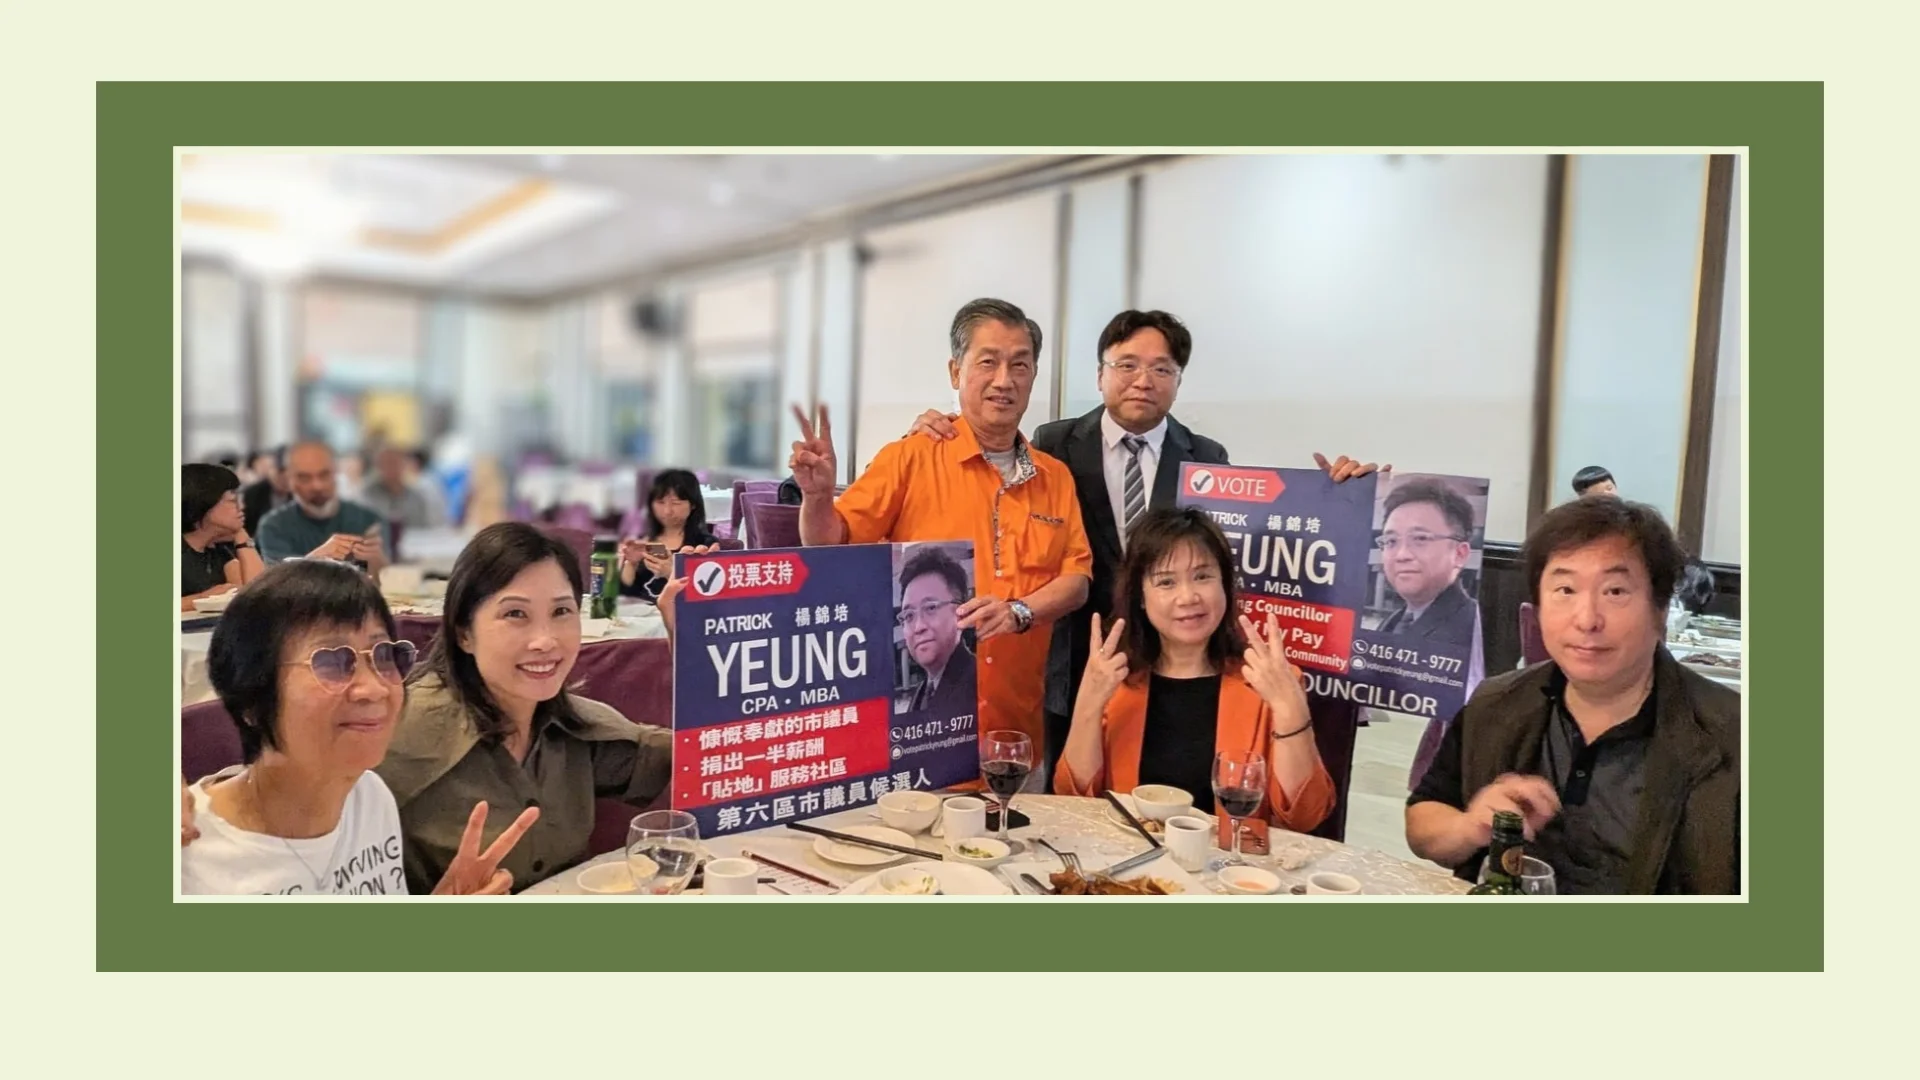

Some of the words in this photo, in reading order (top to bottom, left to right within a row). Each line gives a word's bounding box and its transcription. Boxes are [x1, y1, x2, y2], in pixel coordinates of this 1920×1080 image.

[1217, 476, 1267, 498] VOTE
[728, 561, 794, 588] 投票支持
[1263, 581, 1304, 598] MBA
[704, 612, 773, 636] PATRICK
[1255, 599, 1333, 623] Councillor
[1291, 627, 1325, 649] Pay
[707, 627, 868, 698] YEUNG
[1285, 646, 1348, 671] Community
[1369, 643, 1393, 660] 416
[1395, 648, 1419, 666] 471
[1429, 654, 1462, 674] 9777
[741, 696, 779, 715] CPA
[801, 686, 840, 706] MBA
[1301, 671, 1438, 716] OUNCILLOR
[699, 706, 860, 751] 慷慨奉獻的市議員
[904, 724, 923, 741] 416
[924, 720, 943, 737] 471
[950, 714, 974, 732] 9777
[700, 737, 825, 777] 捐出一半薪酬
[716, 767, 932, 832] 第六區市議員候選人
